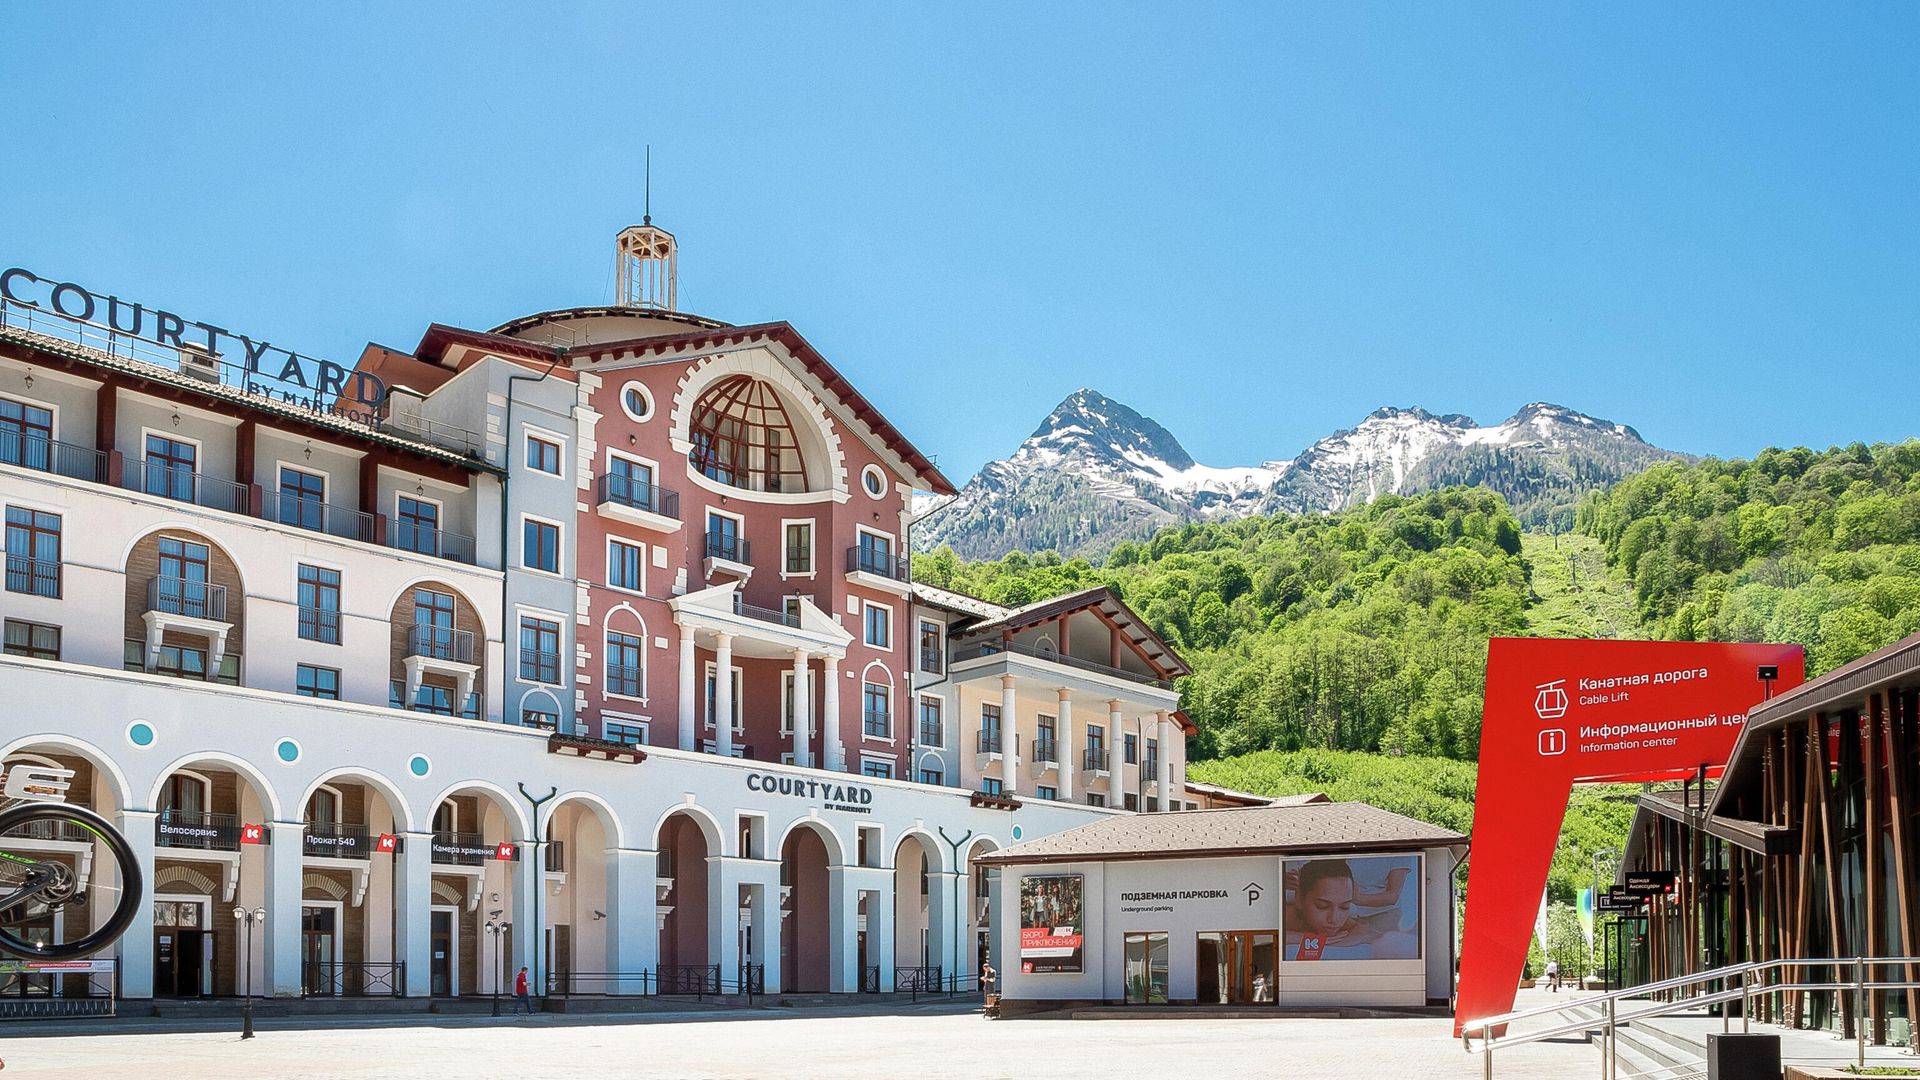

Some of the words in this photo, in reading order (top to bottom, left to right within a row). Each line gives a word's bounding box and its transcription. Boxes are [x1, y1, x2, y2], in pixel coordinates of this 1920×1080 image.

[0, 267, 387, 407] COURTYARD
[249, 382, 274, 399] BY
[283, 391, 384, 431] MARRIOTT
[1579, 674, 1650, 691] Канатная
[1653, 667, 1708, 685] дорога
[1579, 694, 1609, 706] Cable
[1611, 692, 1629, 702] Lift
[1580, 714, 1718, 739] Информационный
[1580, 740, 1640, 753] Information
[1642, 737, 1678, 748] center
[746, 773, 873, 805] COURTYARD
[824, 803, 834, 811] BY
[836, 804, 872, 814] MARRIOTT
[160, 824, 218, 837] Велосервис
[306, 835, 337, 846] Прокат
[338, 837, 355, 846] 540
[432, 844, 460, 854] Камера
[460, 847, 495, 856] хранения
[1121, 891, 1177, 902] ПОДЗЕМНАЯ
[1179, 890, 1228, 899] ПАРКОВКА
[1022, 931, 1044, 939] БЮРО
[1022, 937, 1078, 947] ПРИКЛЮЧЕНИЙ
